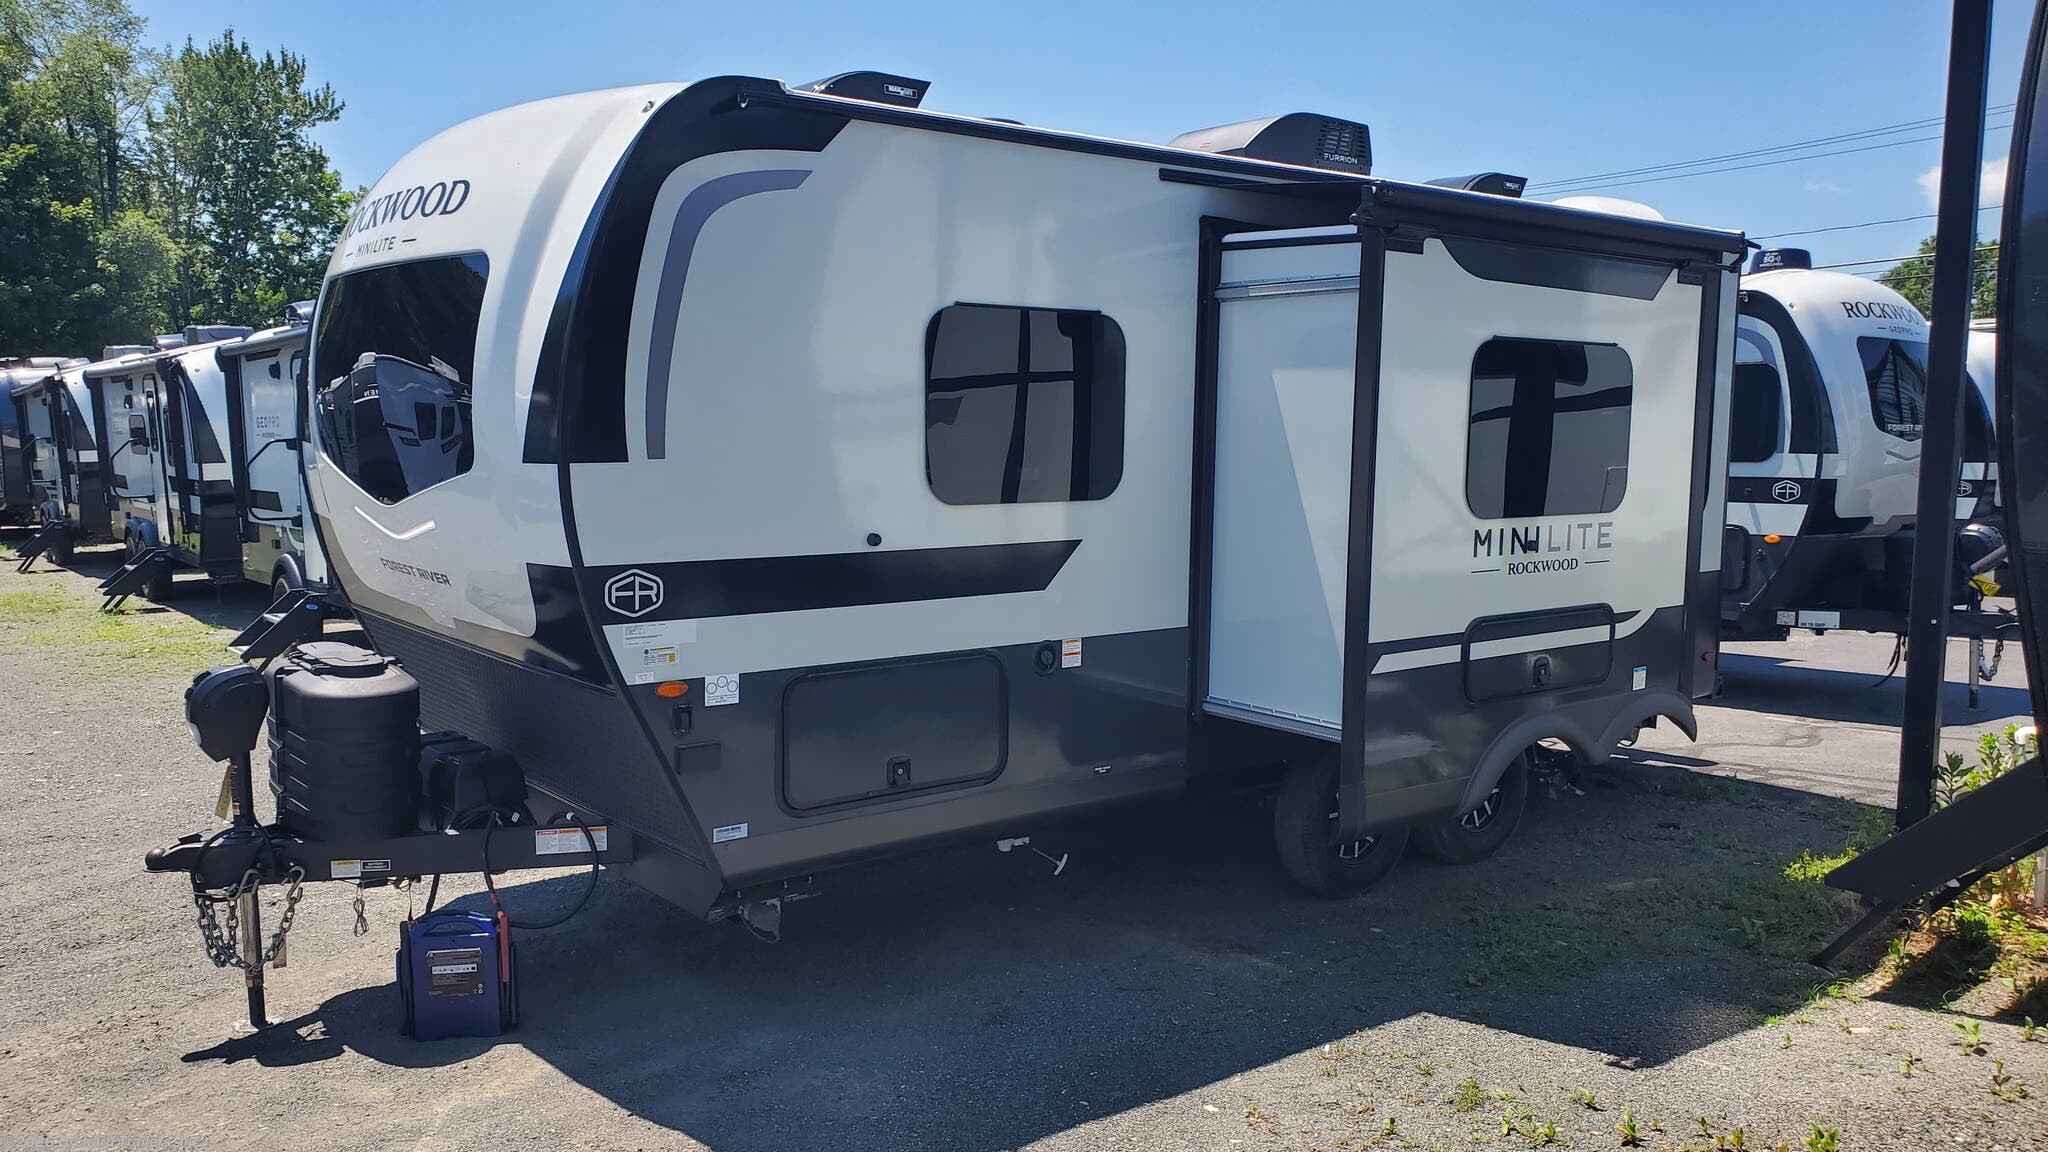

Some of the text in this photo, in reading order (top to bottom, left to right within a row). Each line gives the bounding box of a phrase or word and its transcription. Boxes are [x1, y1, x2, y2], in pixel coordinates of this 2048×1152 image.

[1323, 153, 1358, 164] FURRION
[357, 236, 396, 257] MINILITE
[1887, 423, 1913, 431] FOREST
[380, 557, 453, 587] FOREST RIVER
[1508, 557, 1579, 575] ROCKWOOD
[611, 575, 658, 611] FR
